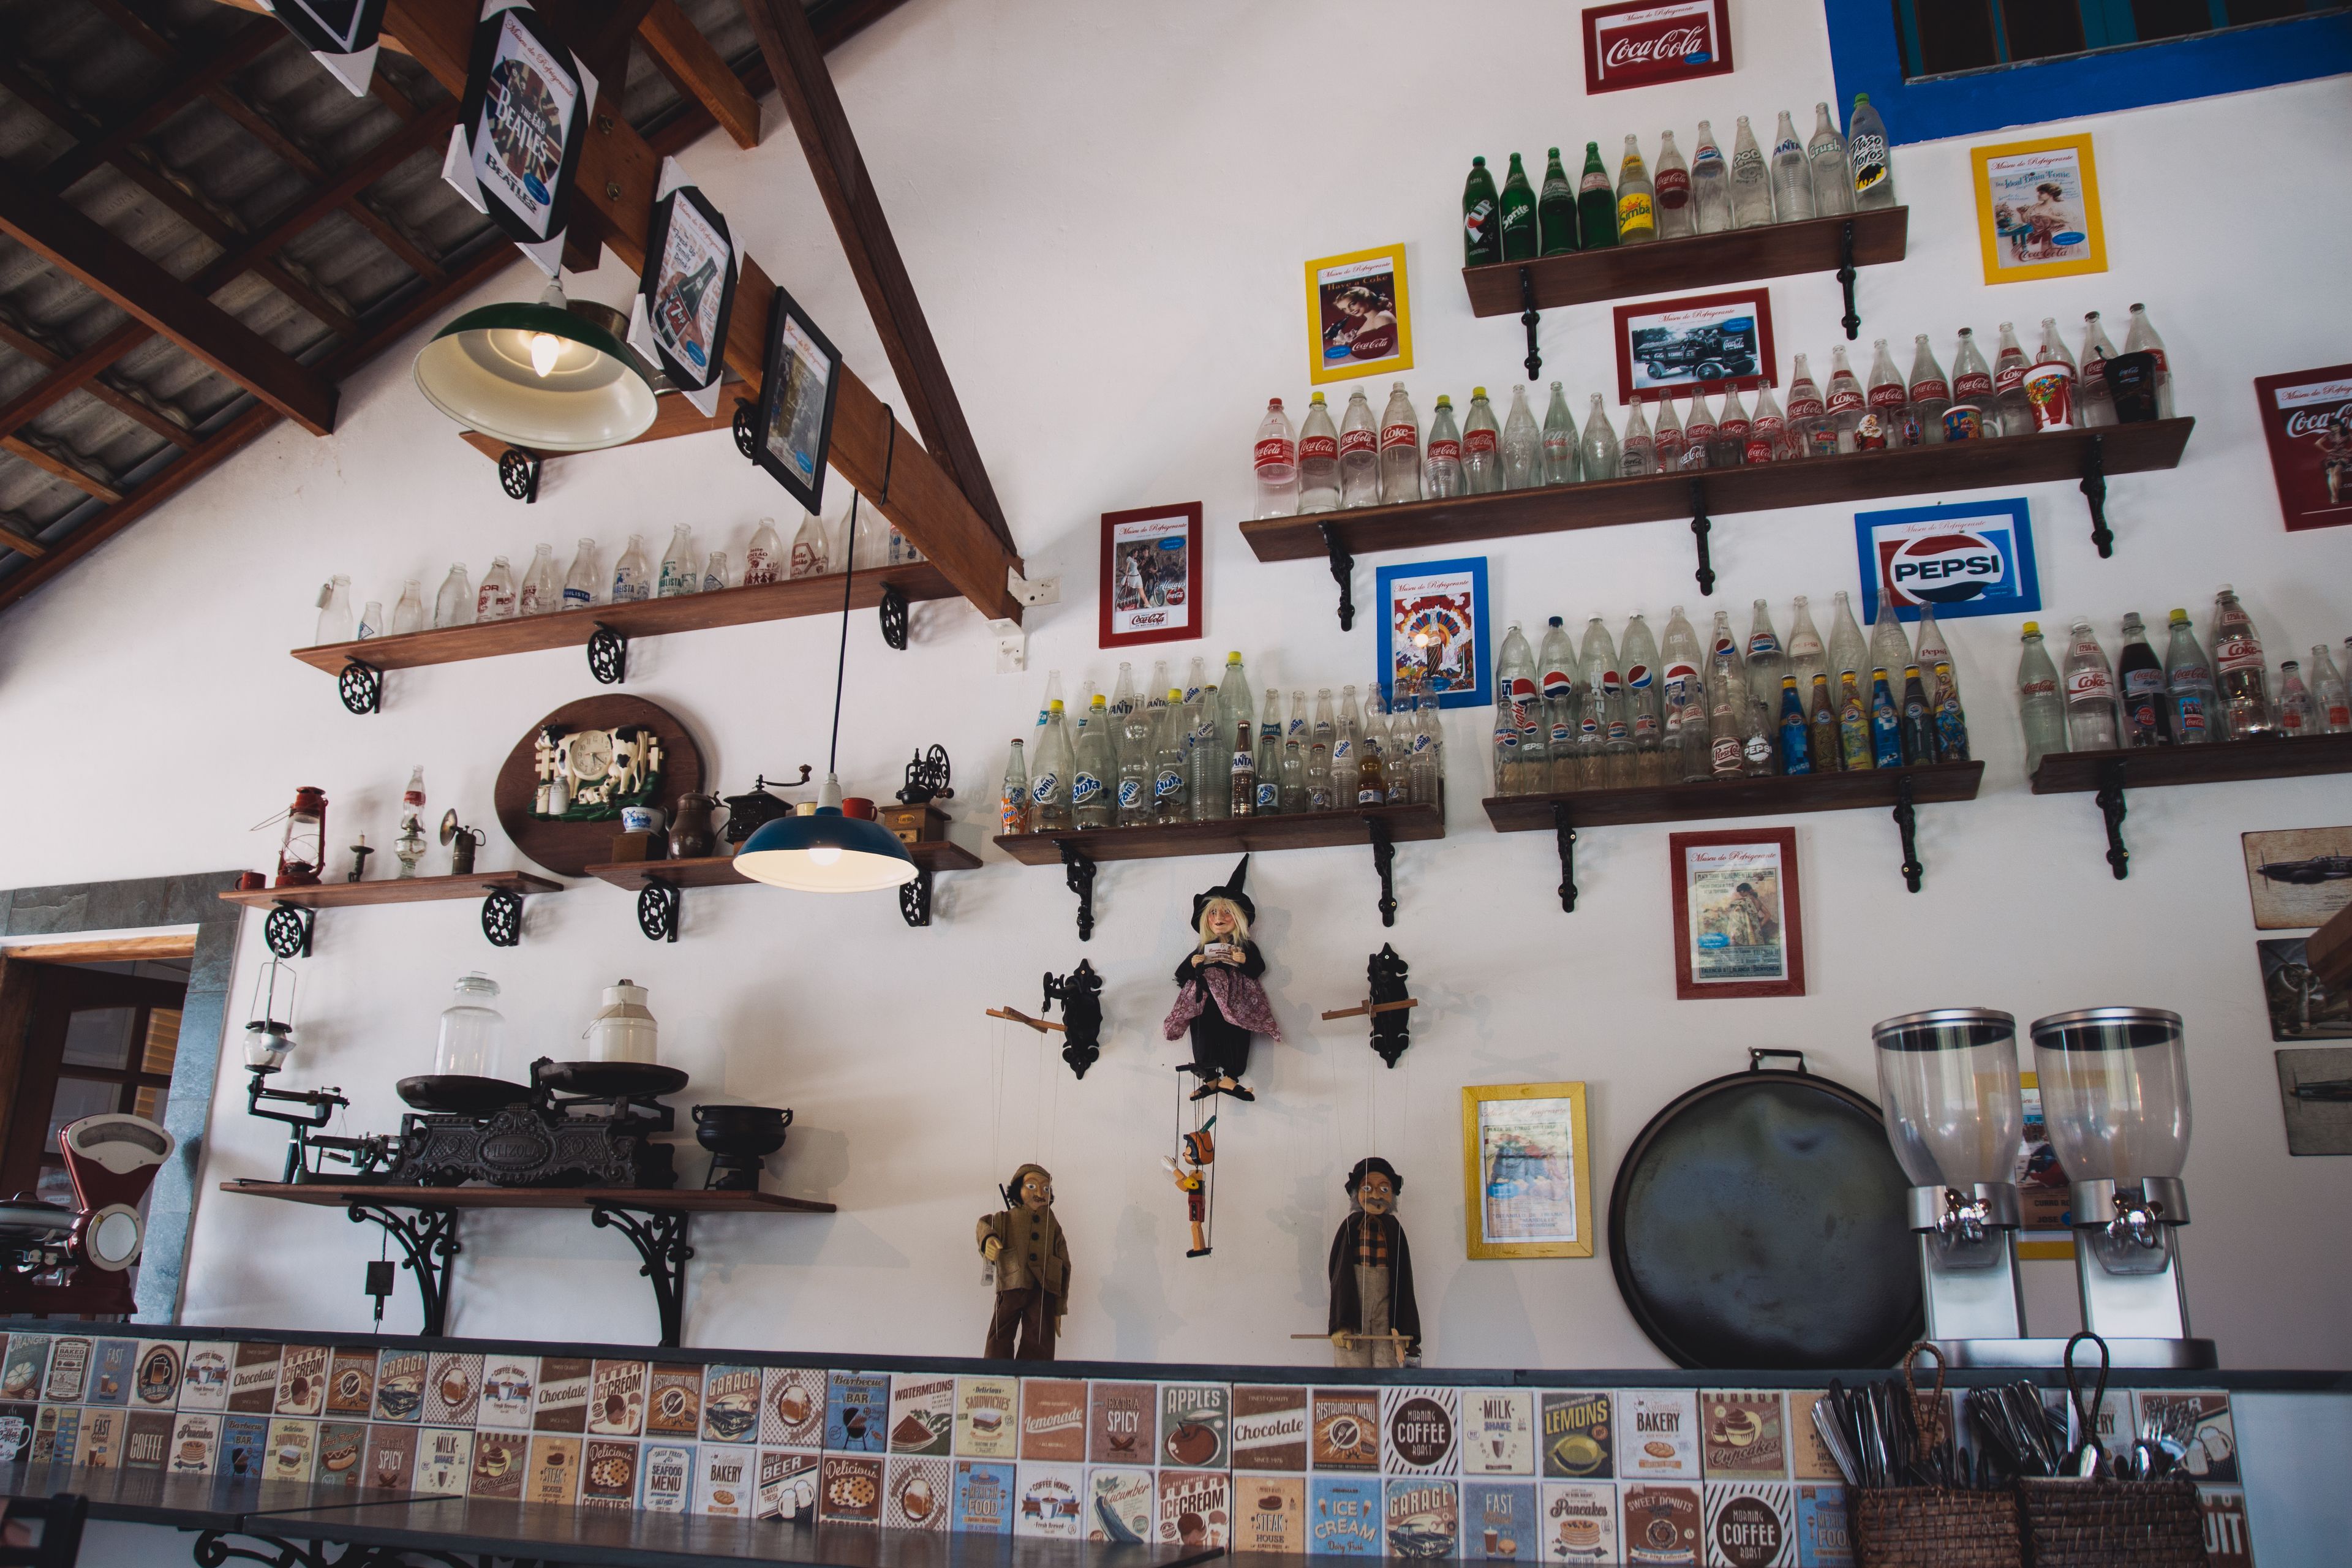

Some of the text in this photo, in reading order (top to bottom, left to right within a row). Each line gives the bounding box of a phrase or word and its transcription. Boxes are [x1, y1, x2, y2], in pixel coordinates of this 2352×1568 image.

[1606, 24, 1707, 67] Coca-Cola
[495, 84, 548, 162] BEATLES
[1809, 138, 1841, 160] Crush
[1851, 135, 1881, 152] Paso
[1852, 149, 1884, 167] Toros
[485, 151, 537, 211] BEATLES
[1656, 170, 1688, 188] Coca-Cola
[1502, 204, 1529, 230] Sprite
[1620, 201, 1651, 227] Simba
[1327, 282, 1351, 291] Have
[1363, 275, 1388, 284] Coke
[1352, 338, 1389, 352] Coca-Cola
[1913, 380, 1943, 393] Coca-Cola
[1958, 377, 1990, 393] Coca-Cola
[1833, 393, 1858, 403] Coke
[1871, 389, 1904, 402] Coca-Cola
[1789, 402, 1823, 416] Coca-Cola
[1341, 431, 1371, 445] Coca-Cola
[1384, 427, 1408, 440] Coke
[1300, 439, 1333, 454] Coca-Cola
[1429, 445, 1457, 456] Coca-Cola
[1747, 448, 1772, 459] Coca-Cola
[1895, 554, 2000, 582] PEPSI
[1157, 579, 1186, 590] Always
[1428, 579, 1469, 590] Refrigerante
[1131, 612, 1166, 625] Coca-Cola
[1921, 647, 1947, 657] Pepsi
[2228, 644, 2258, 656] Coke
[2078, 675, 2105, 688] Coke
[2134, 670, 2162, 680] Coca-Cola
[2174, 666, 2208, 681] Coca-Cola
[2024, 679, 2055, 695] Coca-Cola
[1335, 739, 1351, 758] Fanta
[1744, 746, 1773, 756] PEPSI
[1232, 753, 1253, 767] FANTA
[1033, 773, 1059, 802] Fanta
[1072, 775, 1102, 804] Fanta
[1154, 775, 1184, 796] Fanta
[1118, 781, 1139, 809] Fanta
[10, 1336, 48, 1352] ORANGES
[382, 1354, 423, 1379] GARAGE
[493, 1366, 527, 1378] COFFEE HOUSE
[233, 1368, 276, 1387] Chocolate
[652, 1374, 700, 1395] RESTAURANT MENU
[709, 1371, 756, 1397] GARAGE
[833, 1374, 884, 1388] Barbecue
[144, 1386, 156, 1396] COLD
[540, 1384, 587, 1404] Chocolate
[845, 1392, 870, 1404] BAR
[895, 1380, 954, 1402] WATERMELONS
[974, 1386, 1003, 1395] Delicious
[965, 1395, 1011, 1411] SANDWICHES
[1107, 1397, 1139, 1410] EXTRA
[1168, 1389, 1221, 1414] APPLES
[1483, 1399, 1512, 1420] MILK
[1025, 1408, 1083, 1434] Lemonade
[1316, 1401, 1376, 1425] RESTAURANT MENU
[1408, 1410, 1436, 1422] MORNING
[1545, 1400, 1608, 1436] LEMONS
[227, 1419, 265, 1432] Barbecue
[1107, 1411, 1140, 1433] SPICY
[1234, 1418, 1304, 1442] Chocolate
[1483, 1422, 1512, 1432] SHAKE
[1637, 1412, 1680, 1433] BAKERY
[178, 1424, 214, 1440] Pancakes
[276, 1434, 310, 1447] SANDWICHES
[1397, 1422, 1446, 1444] COFFEE
[130, 1432, 164, 1461] COFFEE
[234, 1436, 252, 1446] BAR
[379, 1437, 404, 1450] EXTRA
[435, 1436, 456, 1454] MILK
[589, 1444, 633, 1462] Delicious
[1412, 1444, 1433, 1457] ROAST
[1709, 1440, 1779, 1468] Cupcakes
[379, 1450, 404, 1471] SPICY
[763, 1454, 780, 1467] COLD
[763, 1455, 802, 1481] BEER
[652, 1465, 683, 1477] SEAFOOD
[710, 1464, 742, 1485] BAKERY
[826, 1460, 879, 1479] Delicious
[474, 1471, 521, 1491] Cupcakes
[542, 1485, 563, 1494] HOUSE
[650, 1476, 682, 1492] MENU
[1033, 1479, 1072, 1493] COFFEE HOUSE
[969, 1483, 998, 1500] MEXICAN
[1103, 1479, 1151, 1506] Cucumber
[968, 1499, 998, 1517] FOOD
[1333, 1499, 1359, 1517] ICE
[1389, 1485, 1449, 1518] GARAGE
[1485, 1494, 1514, 1515] FAST
[1550, 1498, 1608, 1518] Pancakes
[1627, 1496, 1694, 1513] SWEET DONUTS
[1256, 1514, 1284, 1532] STEAK
[1733, 1509, 1763, 1523] MORNING
[1256, 1534, 1284, 1544] HOUSE
[1315, 1518, 1378, 1543] CREAM
[1722, 1522, 1776, 1547] COFFEE
[1328, 1541, 1364, 1553] Dairy Fresh
[1740, 1546, 1762, 1559] ROAST
